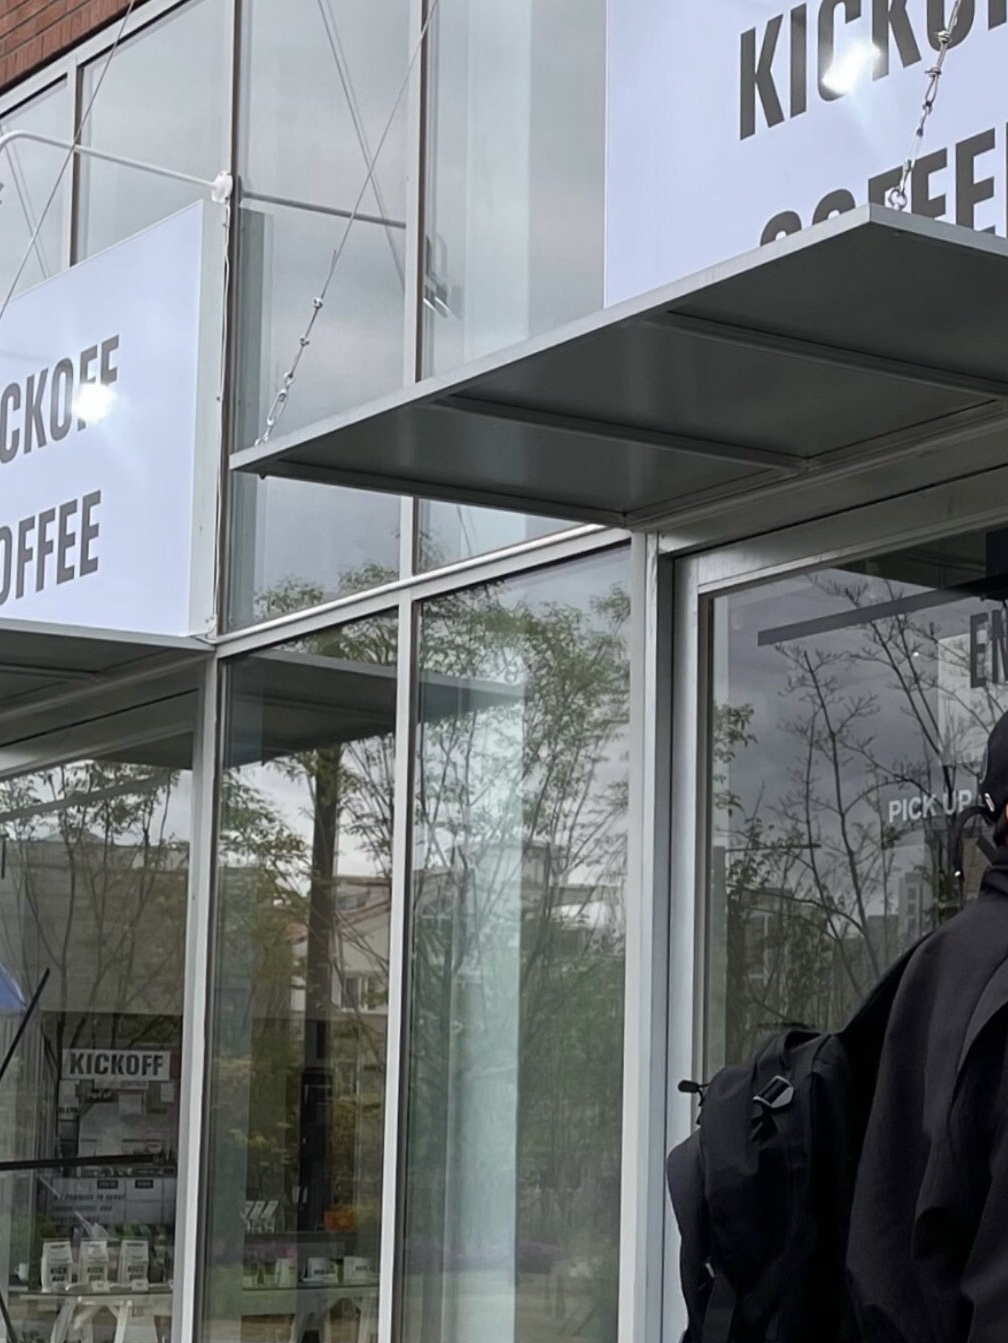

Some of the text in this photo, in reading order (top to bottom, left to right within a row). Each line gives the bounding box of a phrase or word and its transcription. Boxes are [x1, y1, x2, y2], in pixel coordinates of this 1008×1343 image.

[888, 789, 972, 823] PICK UP
[69, 1052, 164, 1076] KICKOFF
